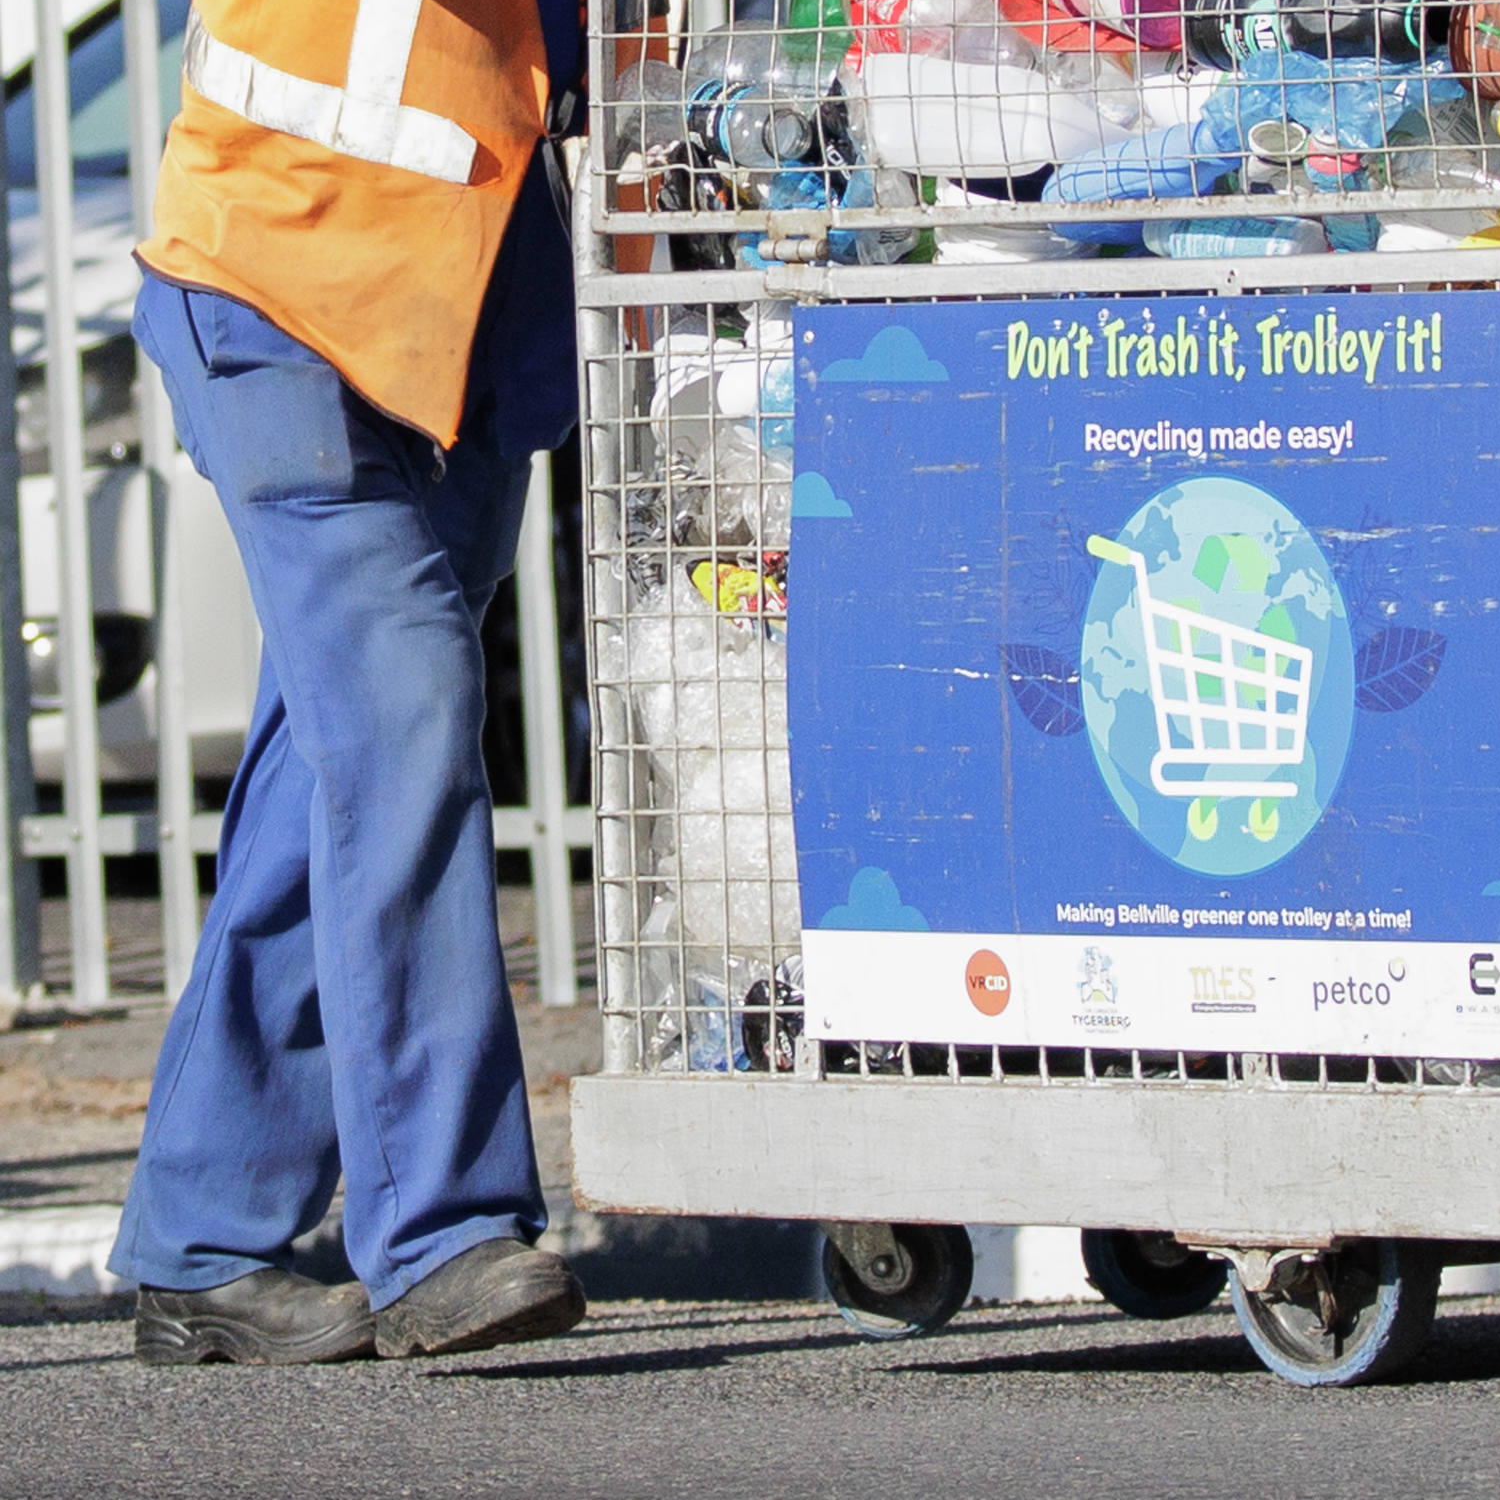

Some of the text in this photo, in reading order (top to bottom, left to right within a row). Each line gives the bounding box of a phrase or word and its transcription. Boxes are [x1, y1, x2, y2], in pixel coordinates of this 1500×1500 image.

[1006, 312, 1443, 384] Don't Trash it, Trolley it!
[1084, 419, 1354, 456] Recycling made easy!
[1056, 903, 1413, 931] Making Bellville greener one trolley at a time!
[1313, 976, 1391, 1012] petco
